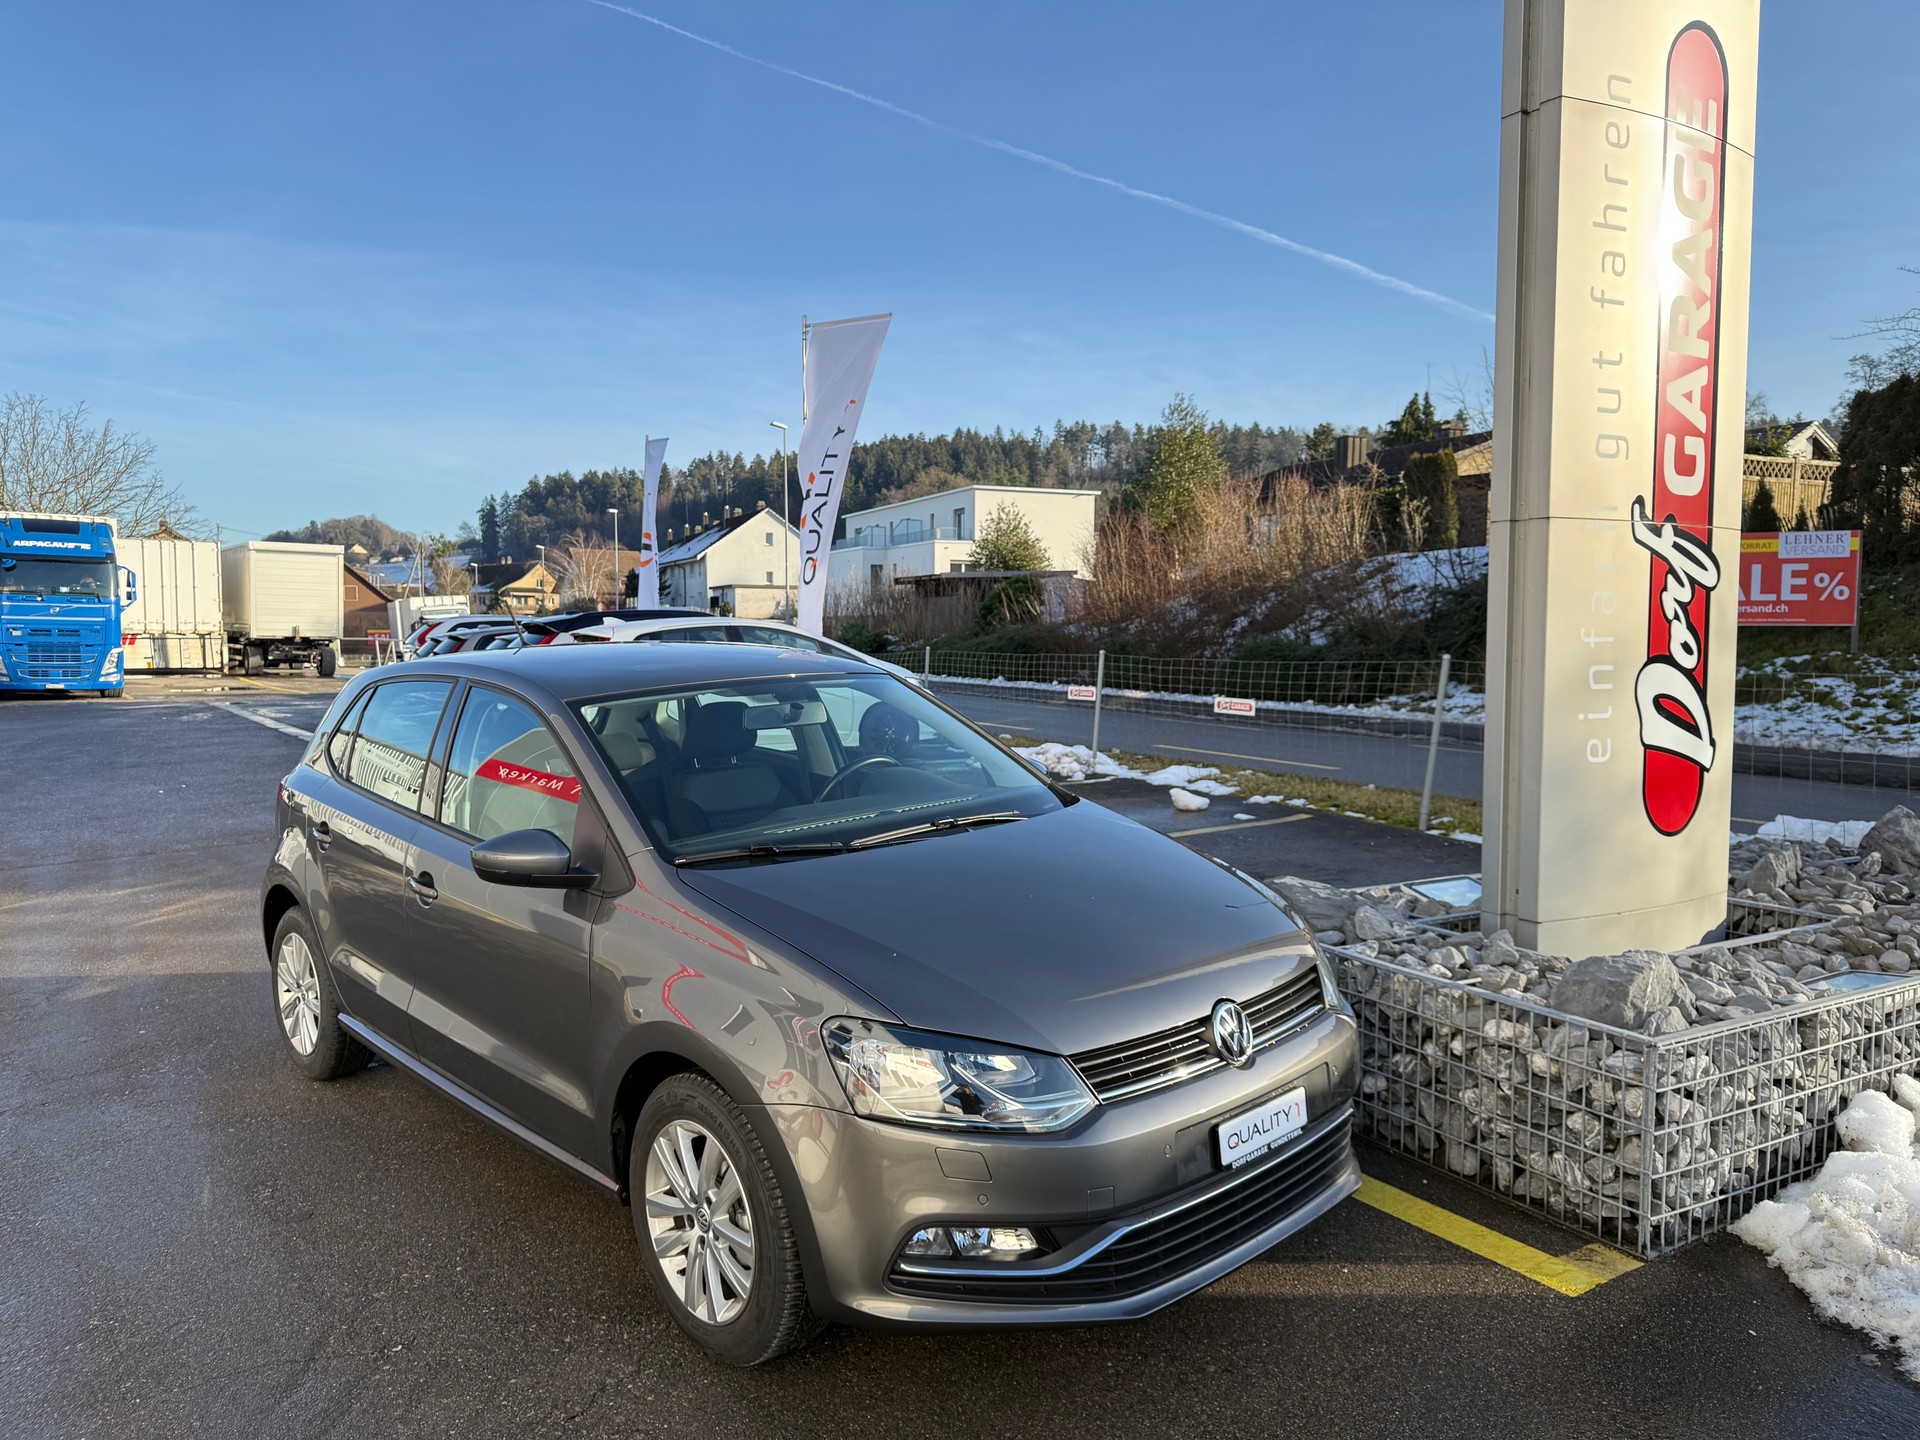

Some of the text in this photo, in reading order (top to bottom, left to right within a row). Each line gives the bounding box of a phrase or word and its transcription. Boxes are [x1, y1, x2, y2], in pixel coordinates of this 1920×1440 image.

[1578, 74, 1633, 764] einfach gut fahren
[1632, 86, 1719, 770] Dorf GARAGE
[803, 425, 845, 585] QUALITY
[13, 540, 76, 549] ARPAGAUS
[1784, 544, 1846, 556] VERSAND
[1785, 533, 1845, 545] LEHNER
[1227, 1102, 1301, 1149] QUALITY 1
[1231, 1145, 1269, 1169] DORFGARAGE
